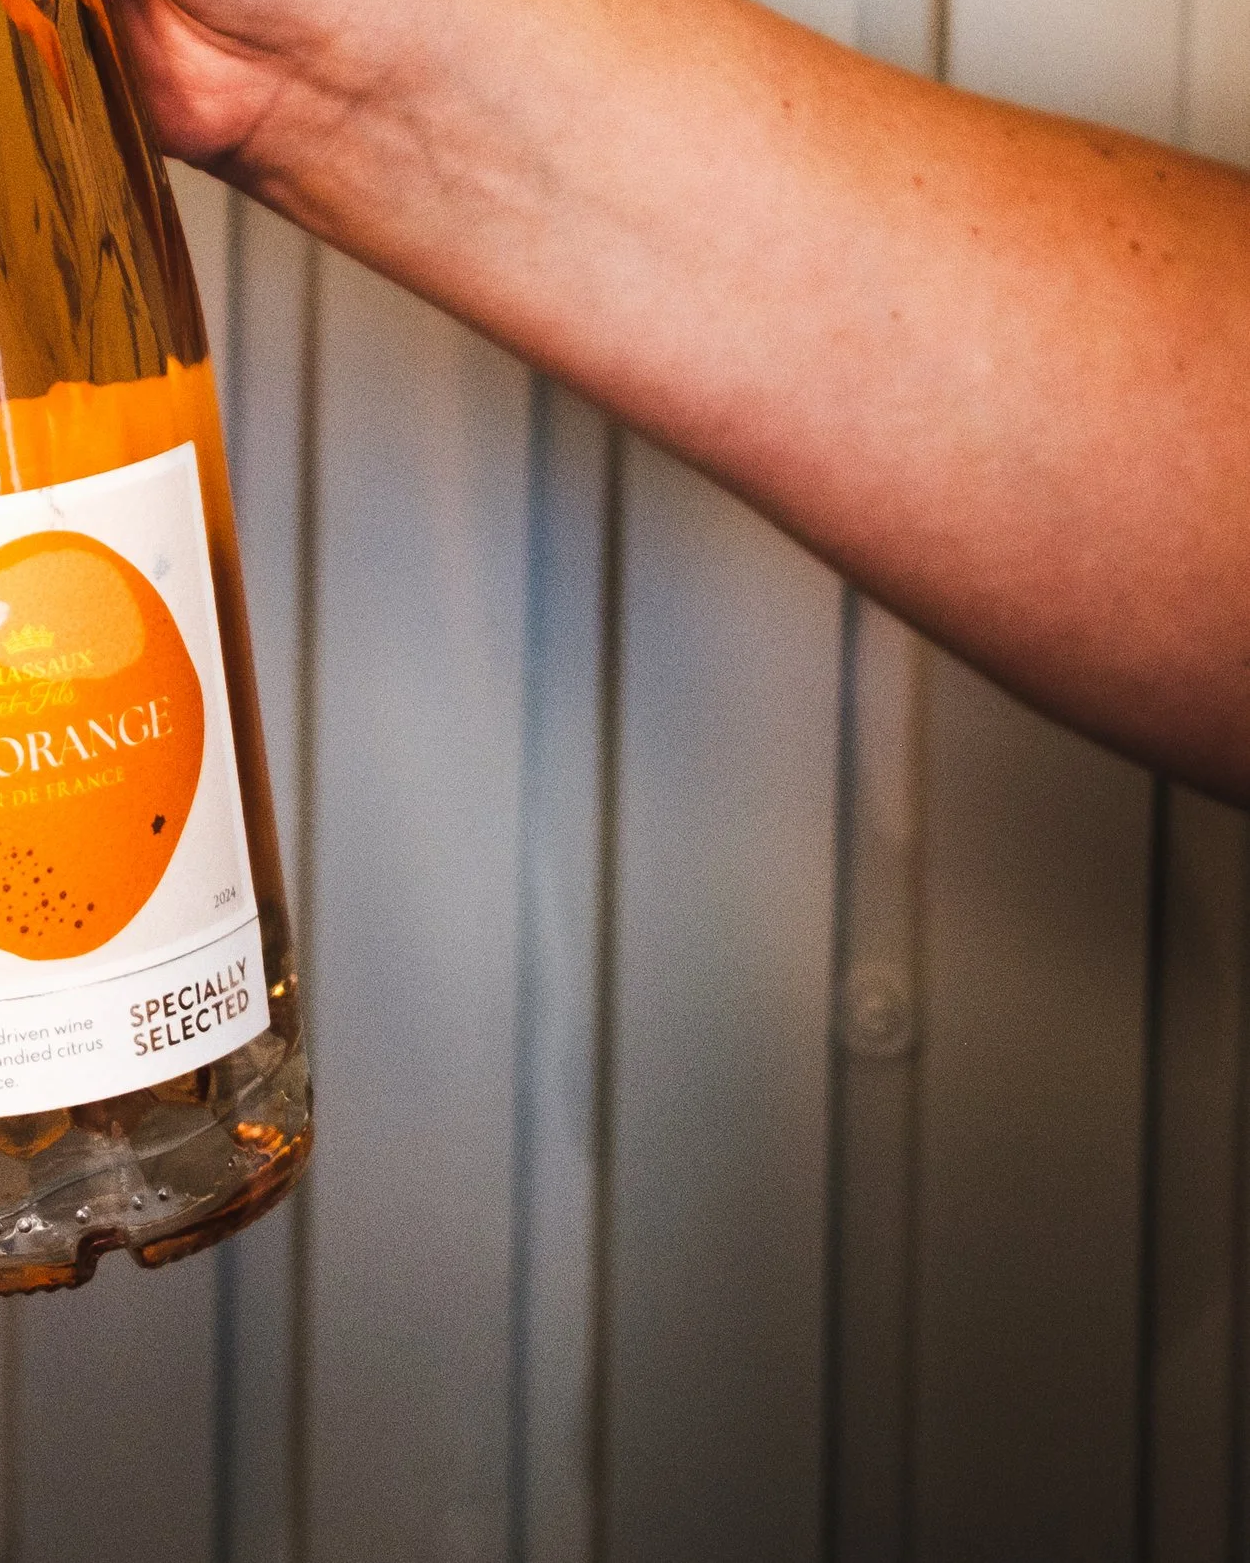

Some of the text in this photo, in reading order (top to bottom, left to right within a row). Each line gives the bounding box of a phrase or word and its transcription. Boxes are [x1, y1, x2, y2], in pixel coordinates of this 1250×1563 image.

[13, 787, 39, 807] DE
[47, 765, 126, 801] FRANCE
[214, 886, 237, 909] 2024
[129, 956, 247, 1028] SPECIALLY
[53, 1017, 95, 1037] wine
[133, 987, 250, 1057] SELECTED
[56, 1037, 104, 1060] citrus
